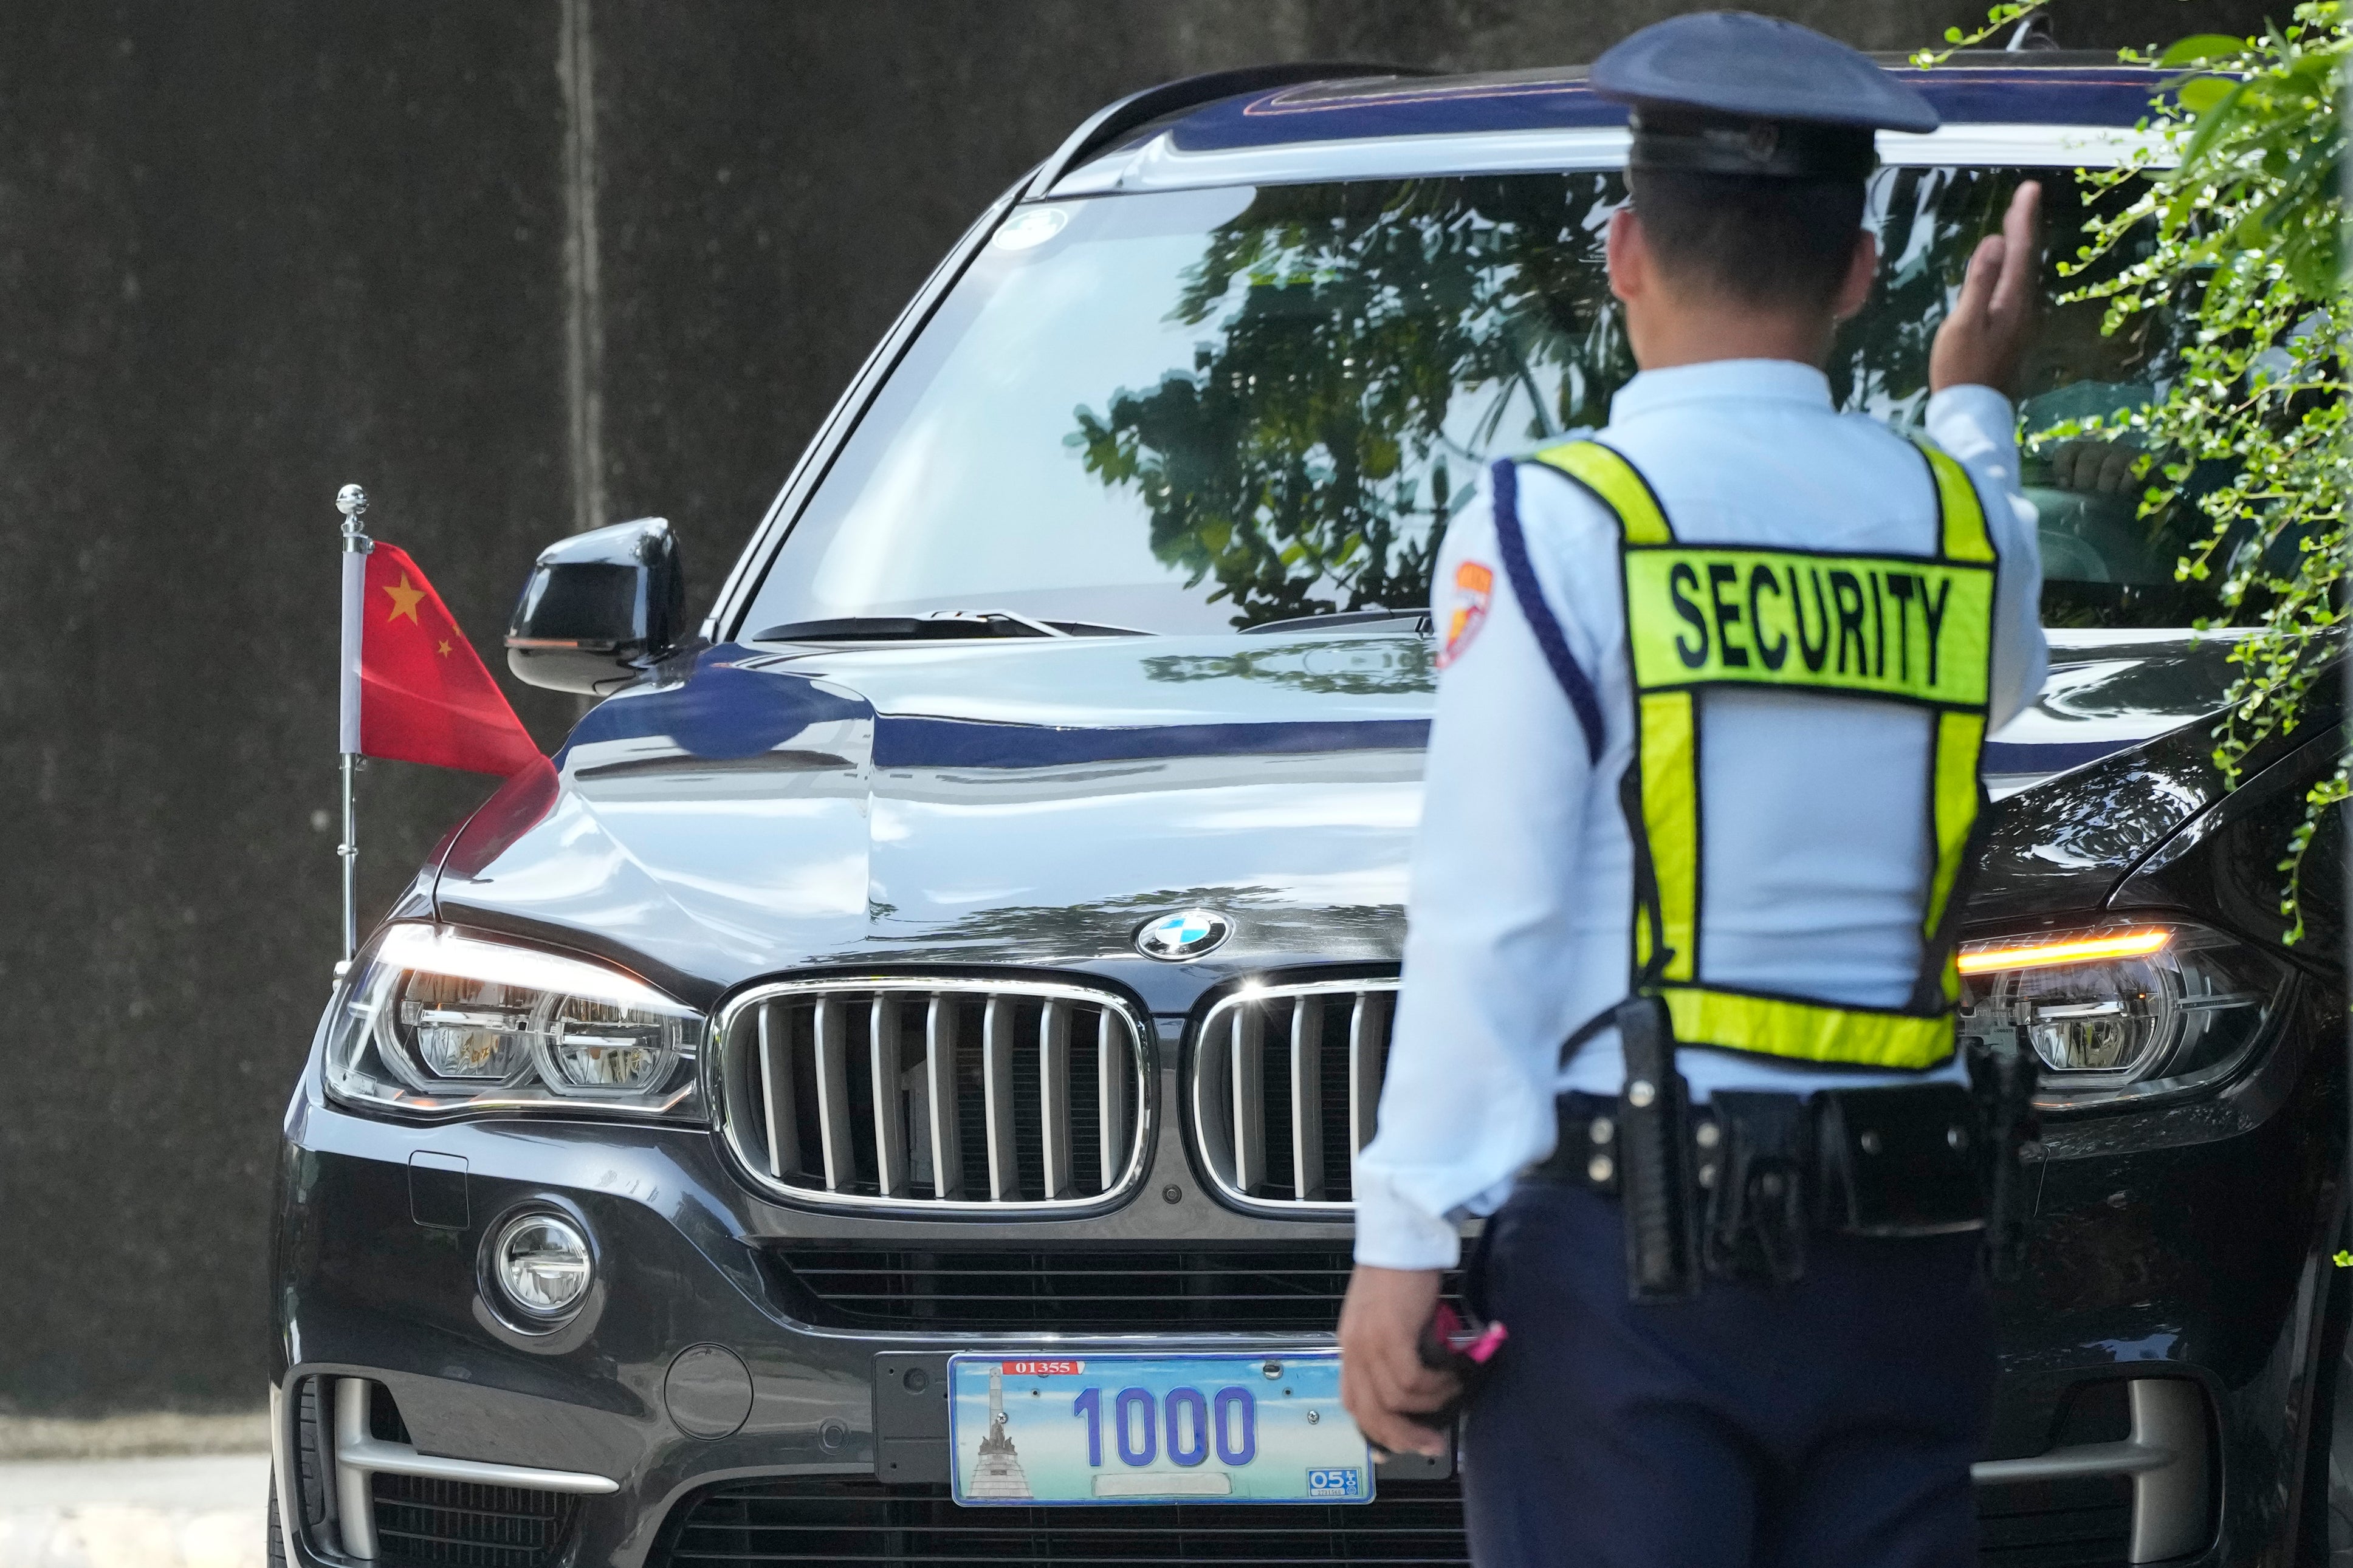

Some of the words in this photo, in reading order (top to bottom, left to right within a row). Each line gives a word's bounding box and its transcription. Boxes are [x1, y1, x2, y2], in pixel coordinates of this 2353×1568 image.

[1670, 561, 1951, 687] SECURITY
[1015, 1362, 1070, 1373] 01355
[1074, 1386, 1257, 1467] 1000
[1311, 1471, 1344, 1488] 05
